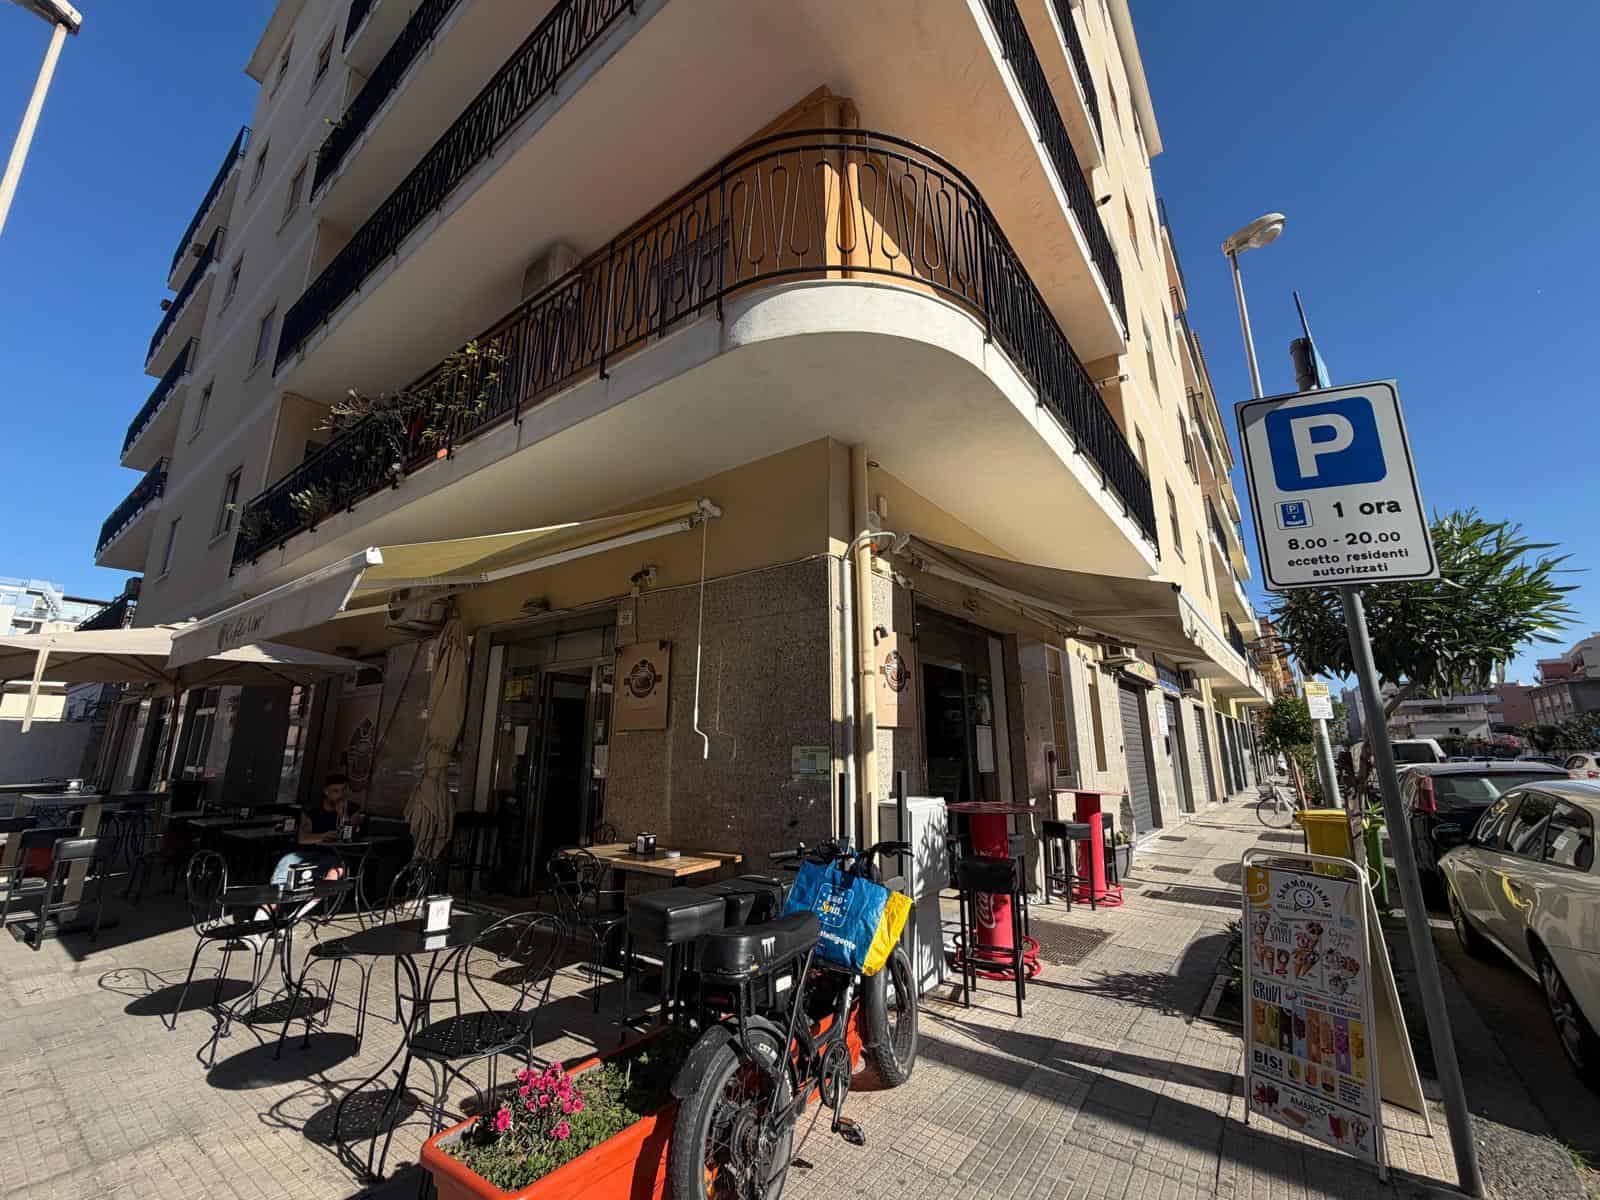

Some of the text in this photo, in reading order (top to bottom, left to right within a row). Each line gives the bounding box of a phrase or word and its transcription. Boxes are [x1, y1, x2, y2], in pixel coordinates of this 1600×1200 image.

[1290, 413, 1355, 479] P
[1332, 499, 1402, 518] 1 ora
[1287, 537, 1328, 551] 8.00
[1345, 531, 1401, 546] 20.00
[1287, 548, 1409, 567] eccetto residenti
[1312, 562, 1389, 578] autorizzati
